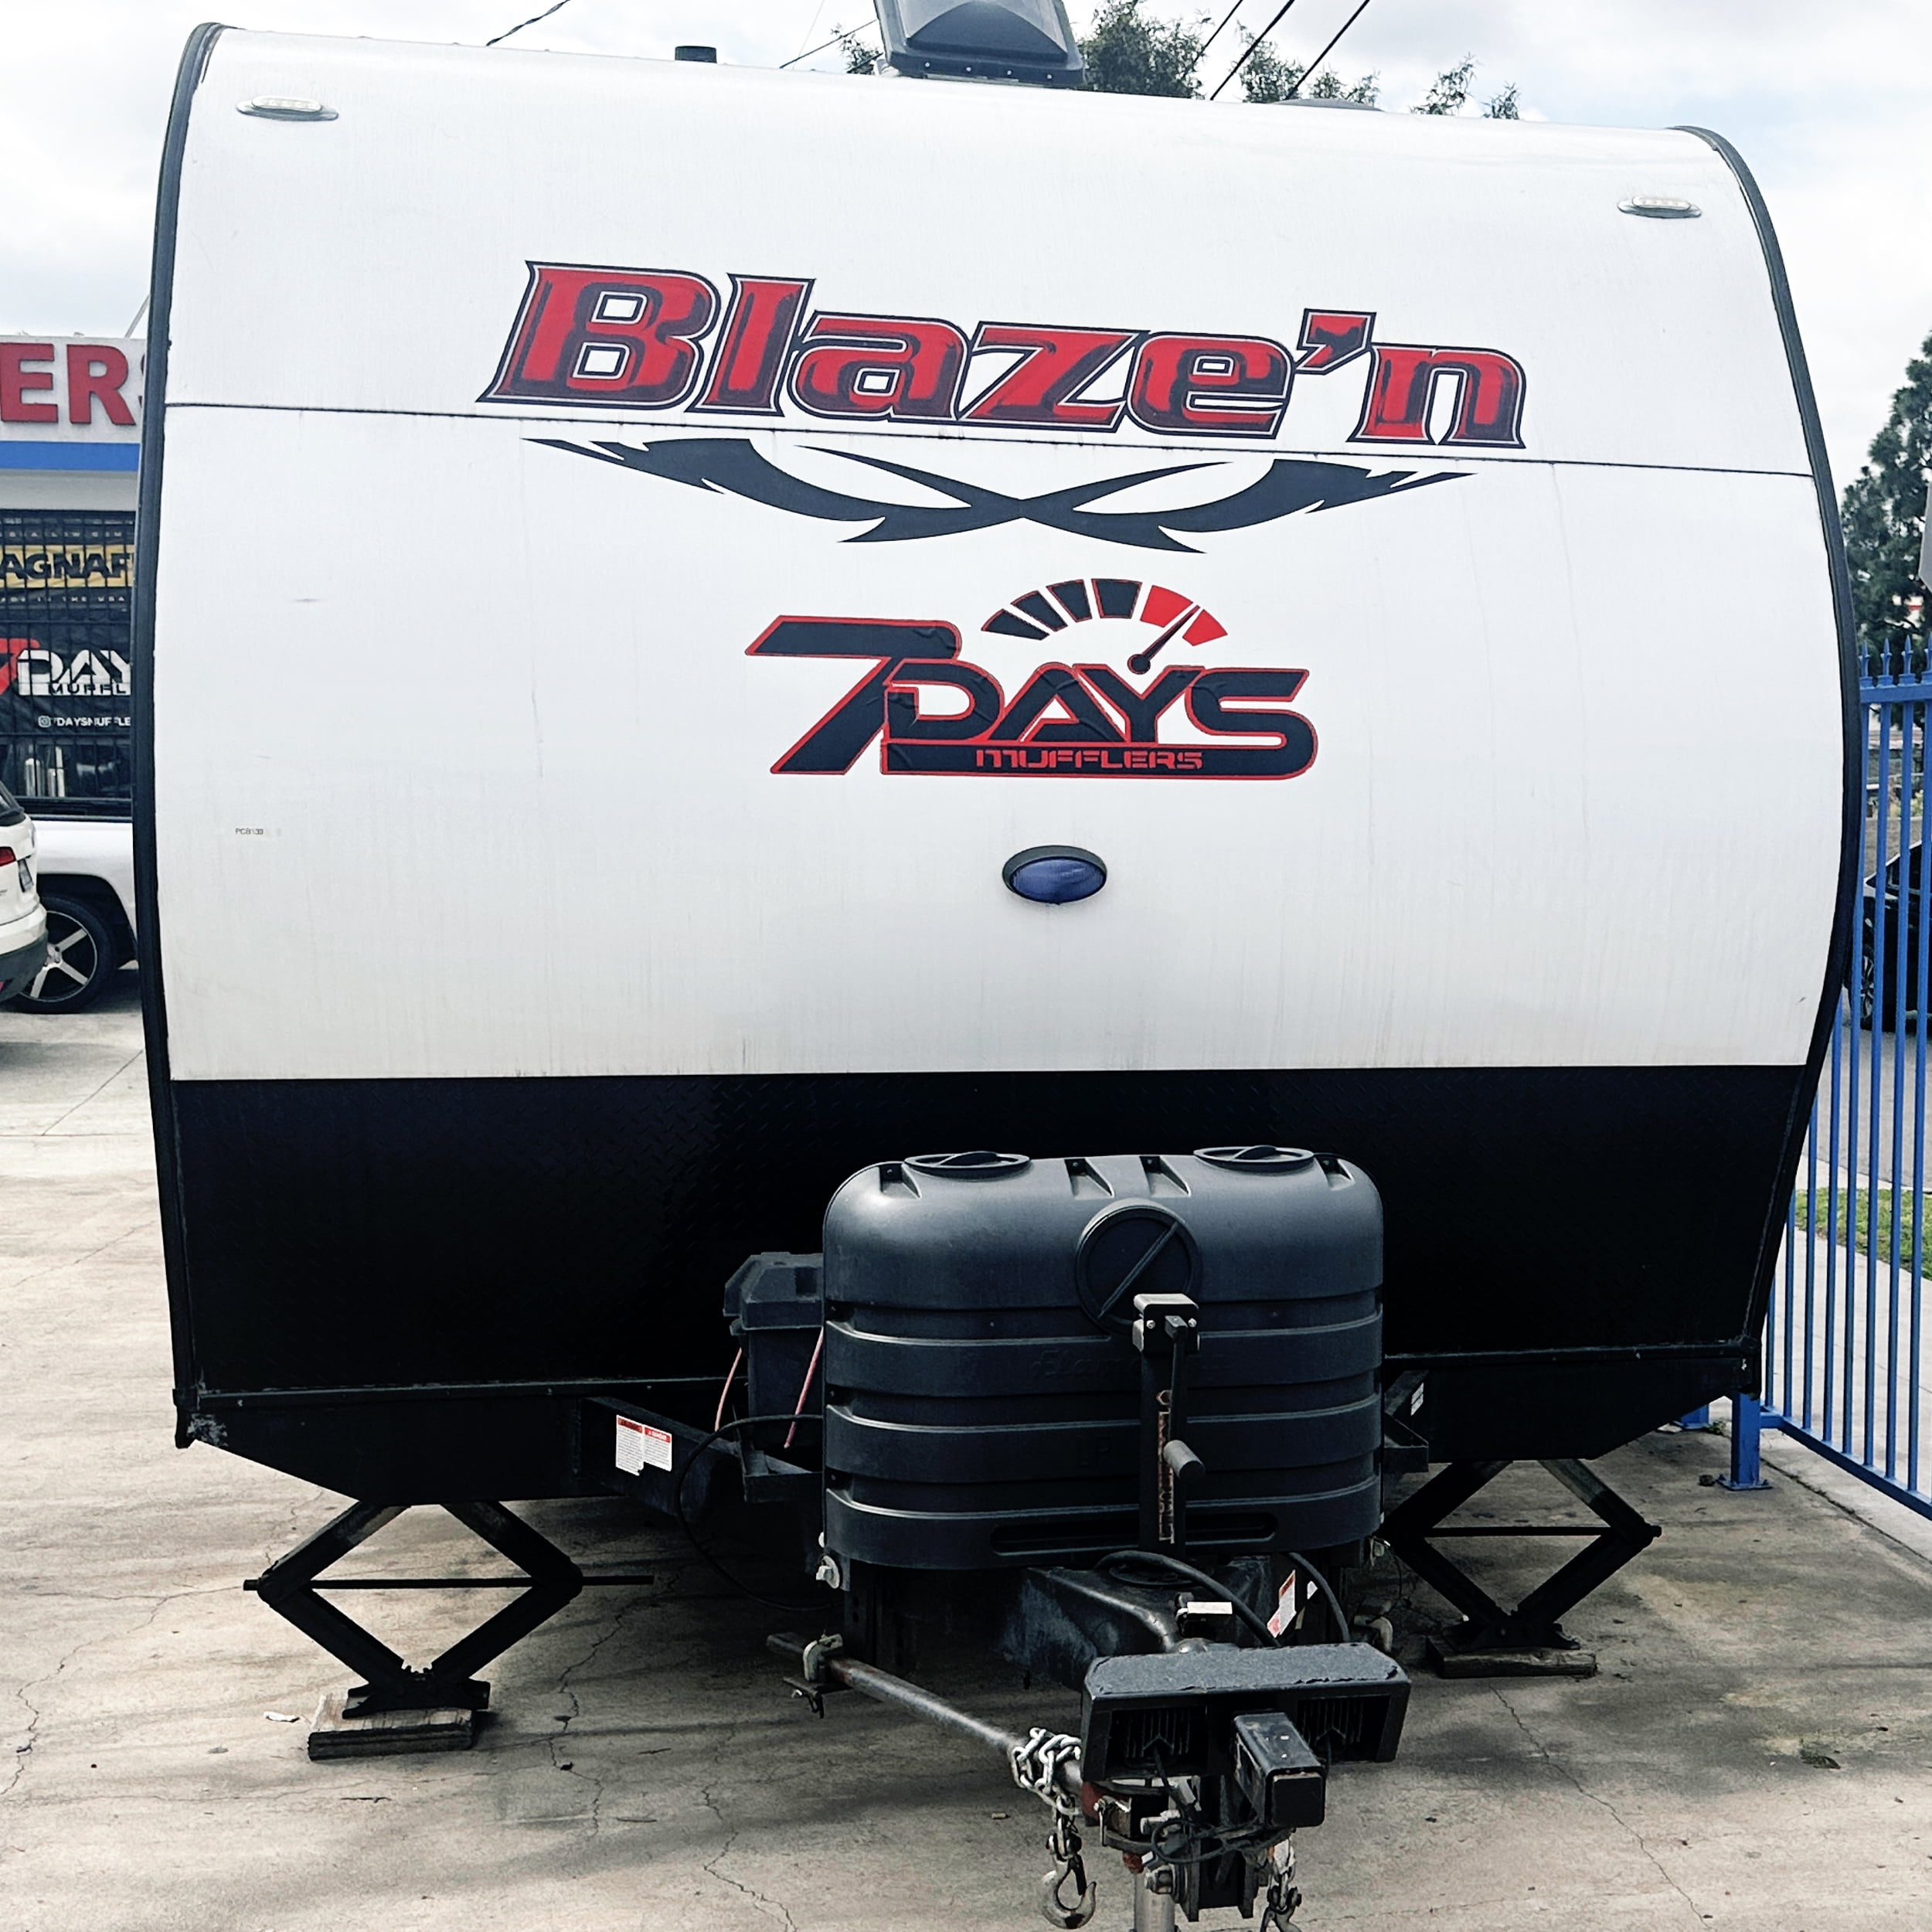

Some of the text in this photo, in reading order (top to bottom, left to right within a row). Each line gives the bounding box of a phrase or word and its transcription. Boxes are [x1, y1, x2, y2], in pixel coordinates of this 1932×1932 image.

[475, 260, 1526, 448] Blaze'n
[0, 342, 145, 426] ER
[0, 553, 134, 580] AGNAF
[976, 750, 1202, 769] MUFFLERS
